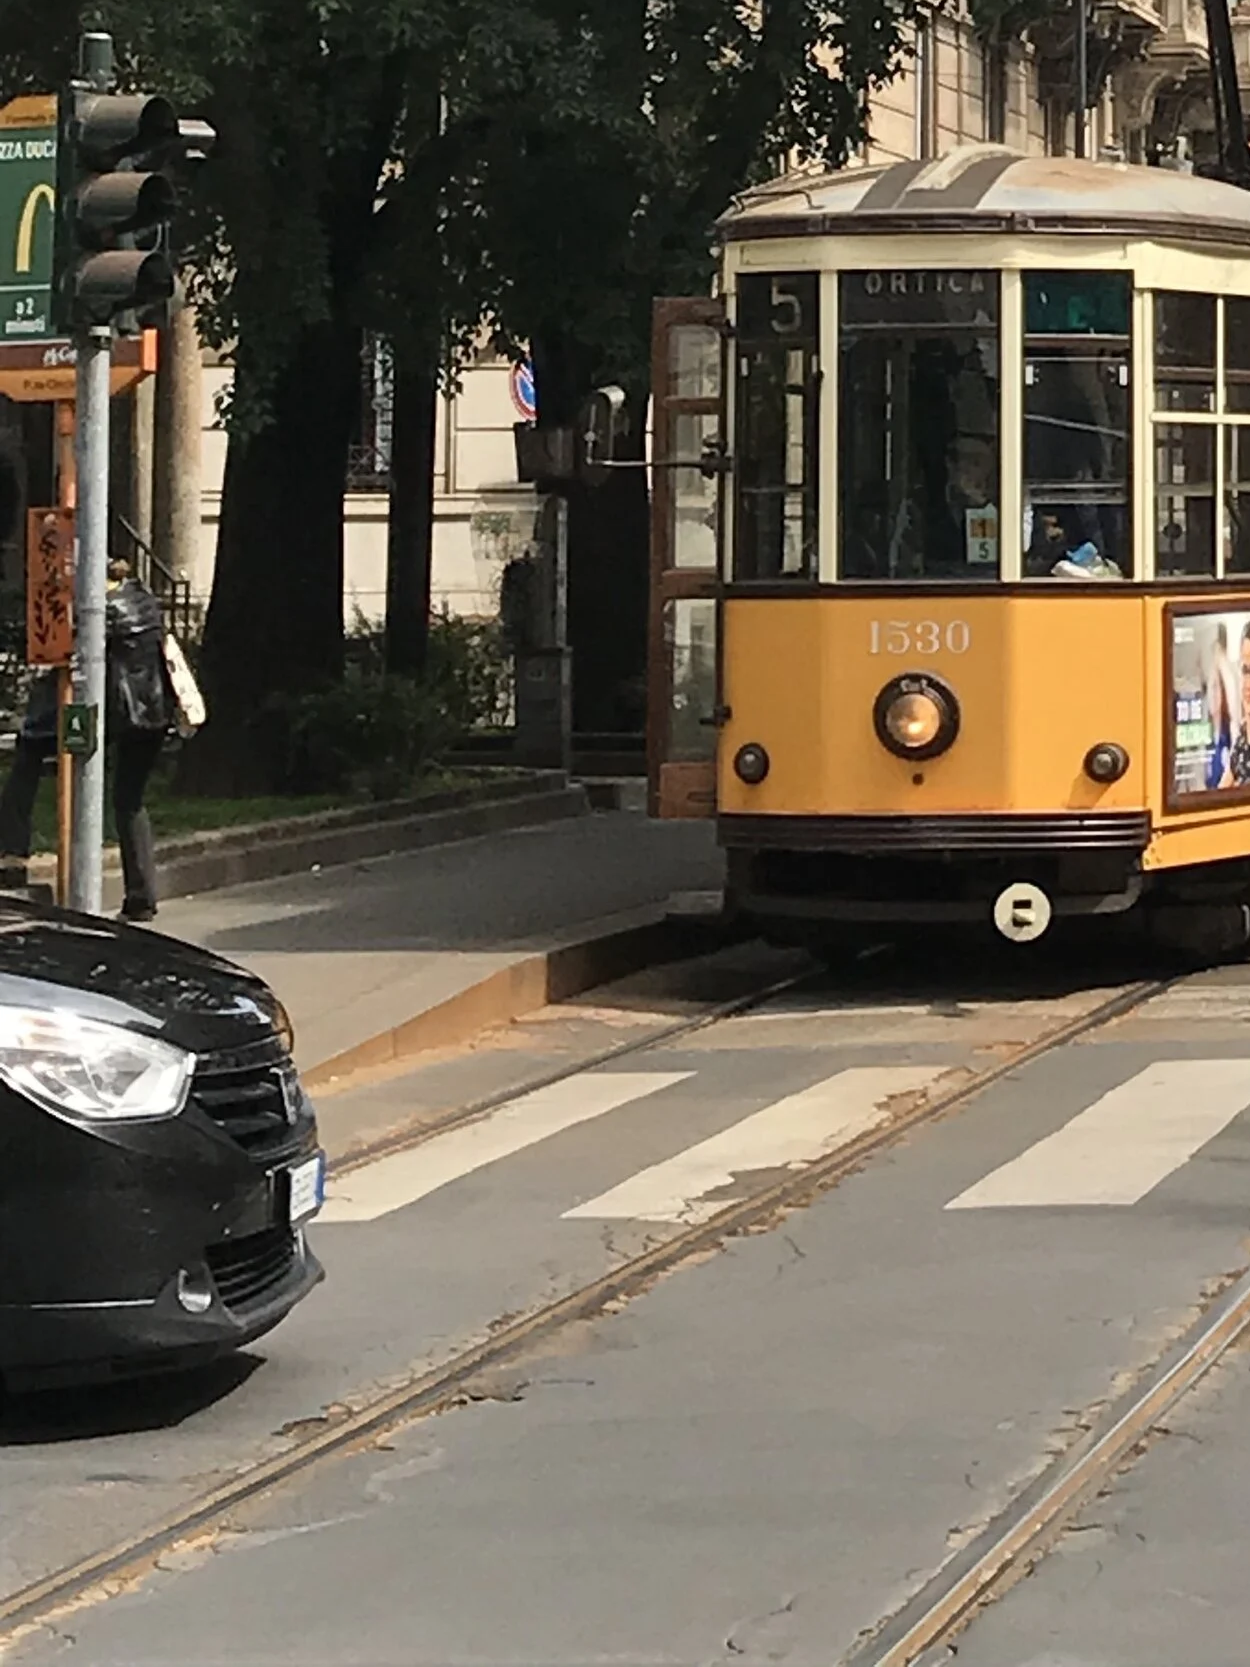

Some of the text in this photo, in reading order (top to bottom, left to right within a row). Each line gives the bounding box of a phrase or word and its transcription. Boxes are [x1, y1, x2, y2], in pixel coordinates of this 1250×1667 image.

[864, 271, 986, 295] ORTICA
[770, 276, 801, 333] 5
[978, 541, 990, 560] 5
[868, 619, 971, 655] 1530
